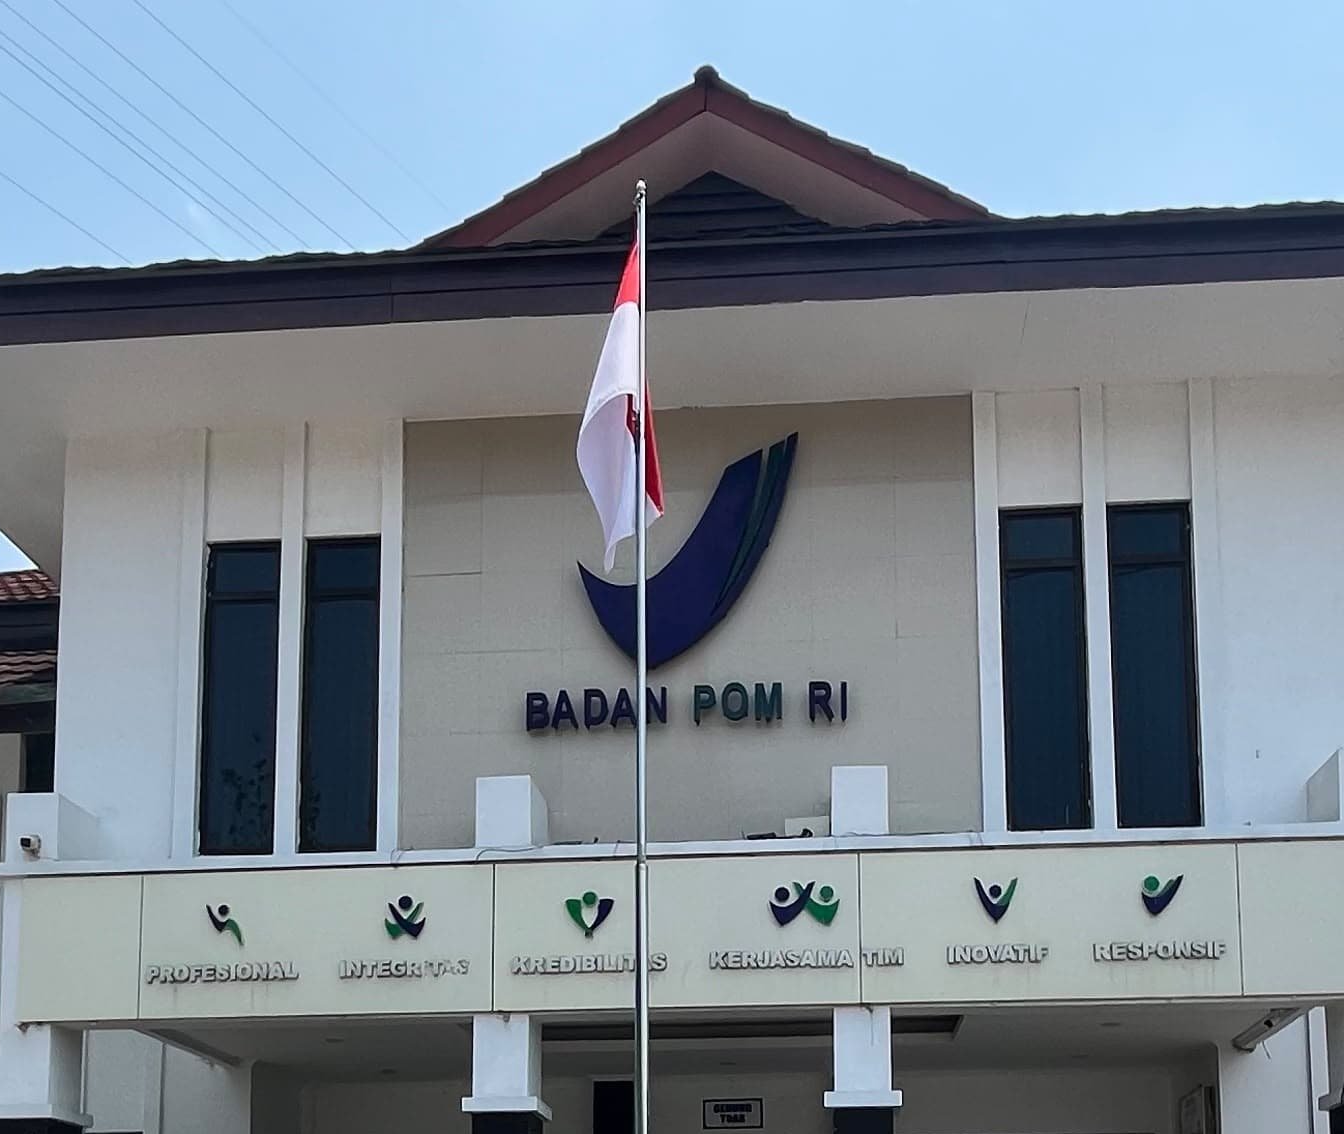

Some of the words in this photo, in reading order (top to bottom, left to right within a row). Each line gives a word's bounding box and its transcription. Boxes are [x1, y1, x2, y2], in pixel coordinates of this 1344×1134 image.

[526, 686, 668, 731] BADAN
[694, 682, 783, 726] POM
[808, 681, 848, 722] RI
[709, 948, 854, 970] KERJASAMA
[863, 947, 905, 967] TIM
[946, 943, 1049, 965] INOVATIF
[1093, 940, 1227, 962] RESPONSIF
[146, 961, 300, 985] PROFESIONAL
[512, 952, 668, 975] KREDIBILITS
